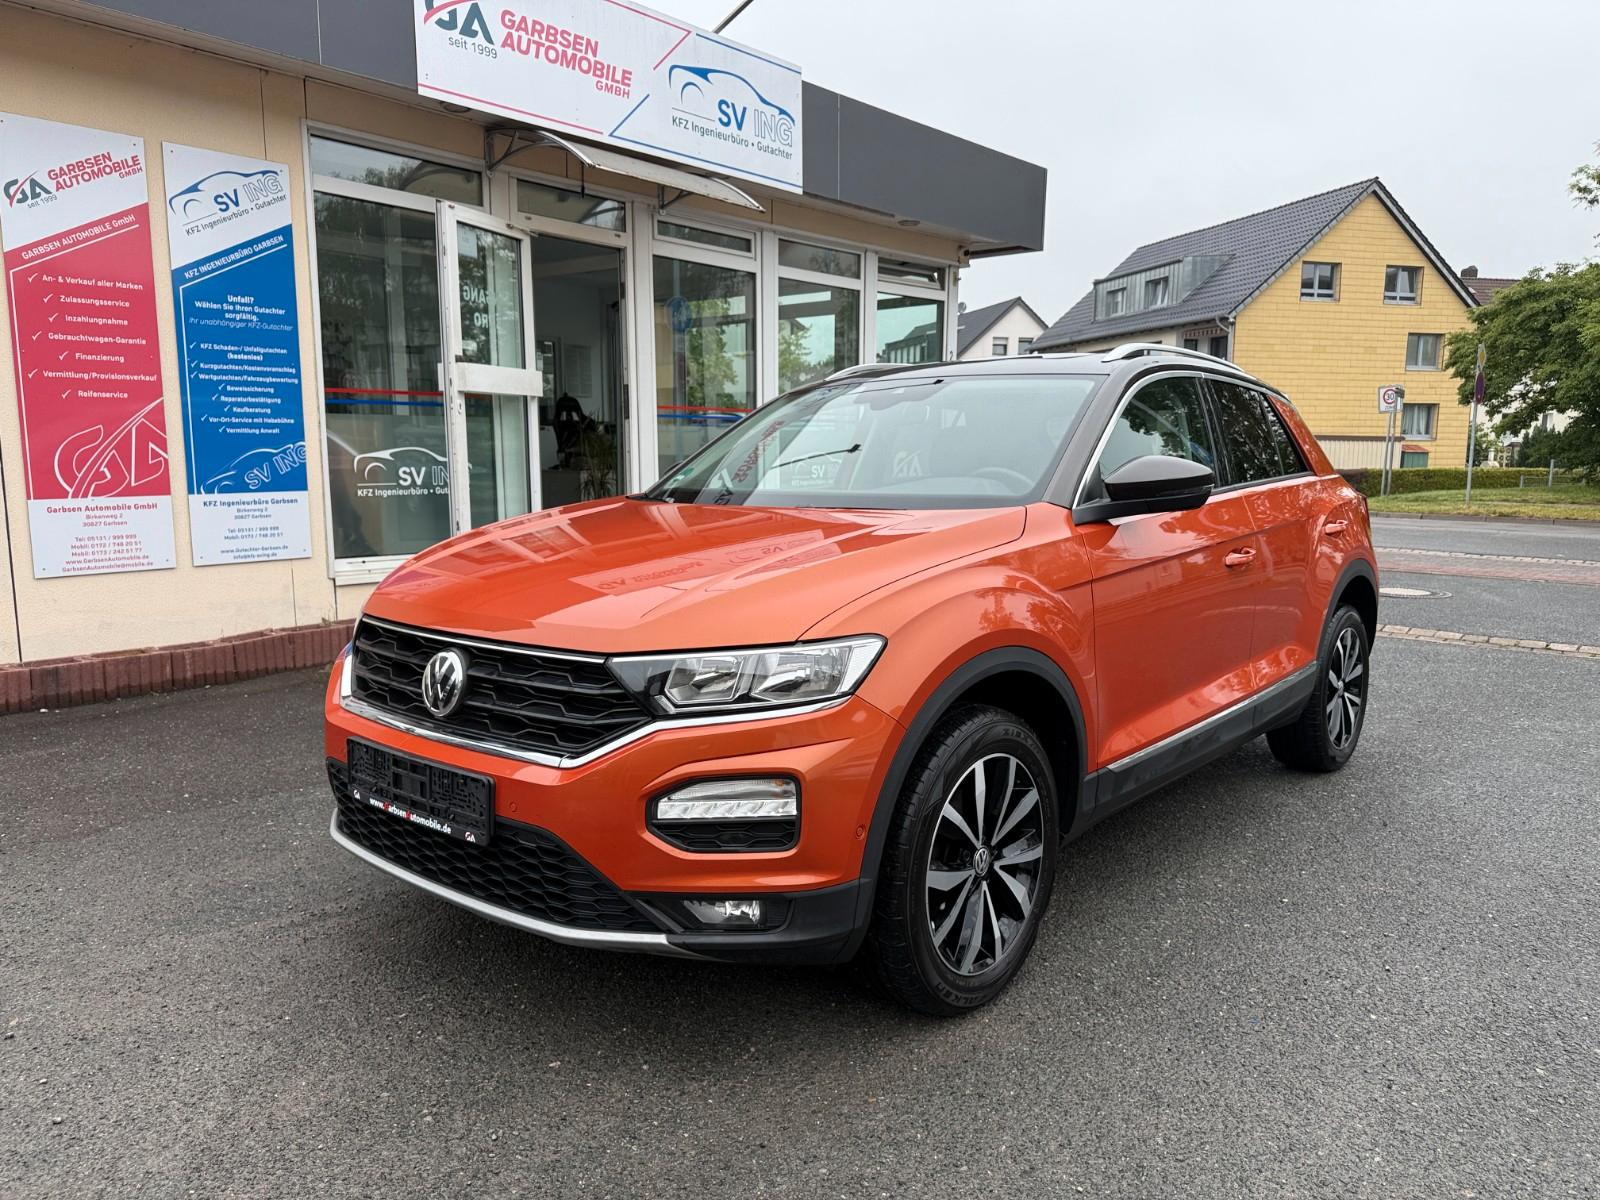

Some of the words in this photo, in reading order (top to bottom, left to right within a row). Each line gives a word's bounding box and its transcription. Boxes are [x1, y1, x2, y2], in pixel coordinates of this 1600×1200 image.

[500, 9, 599, 58] GARBSEN
[448, 36, 467, 50] seit
[471, 42, 497, 59] 1999
[500, 31, 633, 88] AUTOMOBILE
[595, 80, 630, 99] GMBH
[718, 98, 747, 131] SV
[753, 109, 793, 147] ING
[672, 115, 689, 130] KFZ
[691, 121, 749, 148] Ingenieurbüro
[757, 141, 793, 160] Gutachter
[47, 151, 113, 181] GARBSEN
[55, 155, 141, 192] AUTOMOBILE
[118, 165, 143, 180] GMBH
[213, 188, 240, 213] SV
[242, 174, 283, 203] ING
[27, 200, 40, 209] seit
[41, 194, 58, 205] 1999
[185, 224, 201, 237] KFZ
[201, 208, 250, 231] Ingenieurbüro
[255, 194, 287, 211] Gutachter
[21, 241, 61, 260] GARBSEN
[62, 222, 112, 246] AUTOMOBILE
[112, 214, 136, 228] GmbH
[184, 268, 200, 280] KFZ
[199, 246, 253, 274] INGENIEURBÜRO
[253, 235, 284, 252] GARBSEN
[42, 274, 56, 282] An-
[65, 277, 95, 286] Verkauf
[97, 280, 114, 288] aller
[115, 281, 143, 290] Marken
[60, 295, 130, 308] Zulassungsservice
[227, 294, 254, 304] Unfall?
[194, 300, 221, 309] Wählen
[222, 303, 233, 311] Sie
[235, 304, 253, 312] Ihren
[254, 306, 285, 315] Gutachter
[65, 314, 128, 326] Inzahlungnahme
[224, 312, 259, 321] sorgfältig.
[248, 322, 293, 332] KFZ-Gutachter
[48, 332, 146, 345] Gebrauchtwagen-Garantie
[75, 353, 125, 363] Finanzierung
[227, 352, 263, 361] (kostenlos)
[43, 370, 157, 381] Vermittlung/Provisionsverkauf
[78, 390, 128, 399] Reifenservice
[233, 406, 271, 414] Kaufberatung
[244, 462, 272, 490] SV
[398, 466, 426, 486] SV
[432, 466, 449, 485] IN
[357, 489, 373, 497] KFZ
[375, 487, 428, 498] Ingenieurbüro
[46, 506, 82, 514] Garbsen
[84, 504, 131, 513] Automobile
[134, 502, 158, 510] GmbH
[219, 498, 269, 508] Ingenieurbüro
[369, 797, 452, 834] www.GarbsenAutomobile.de
